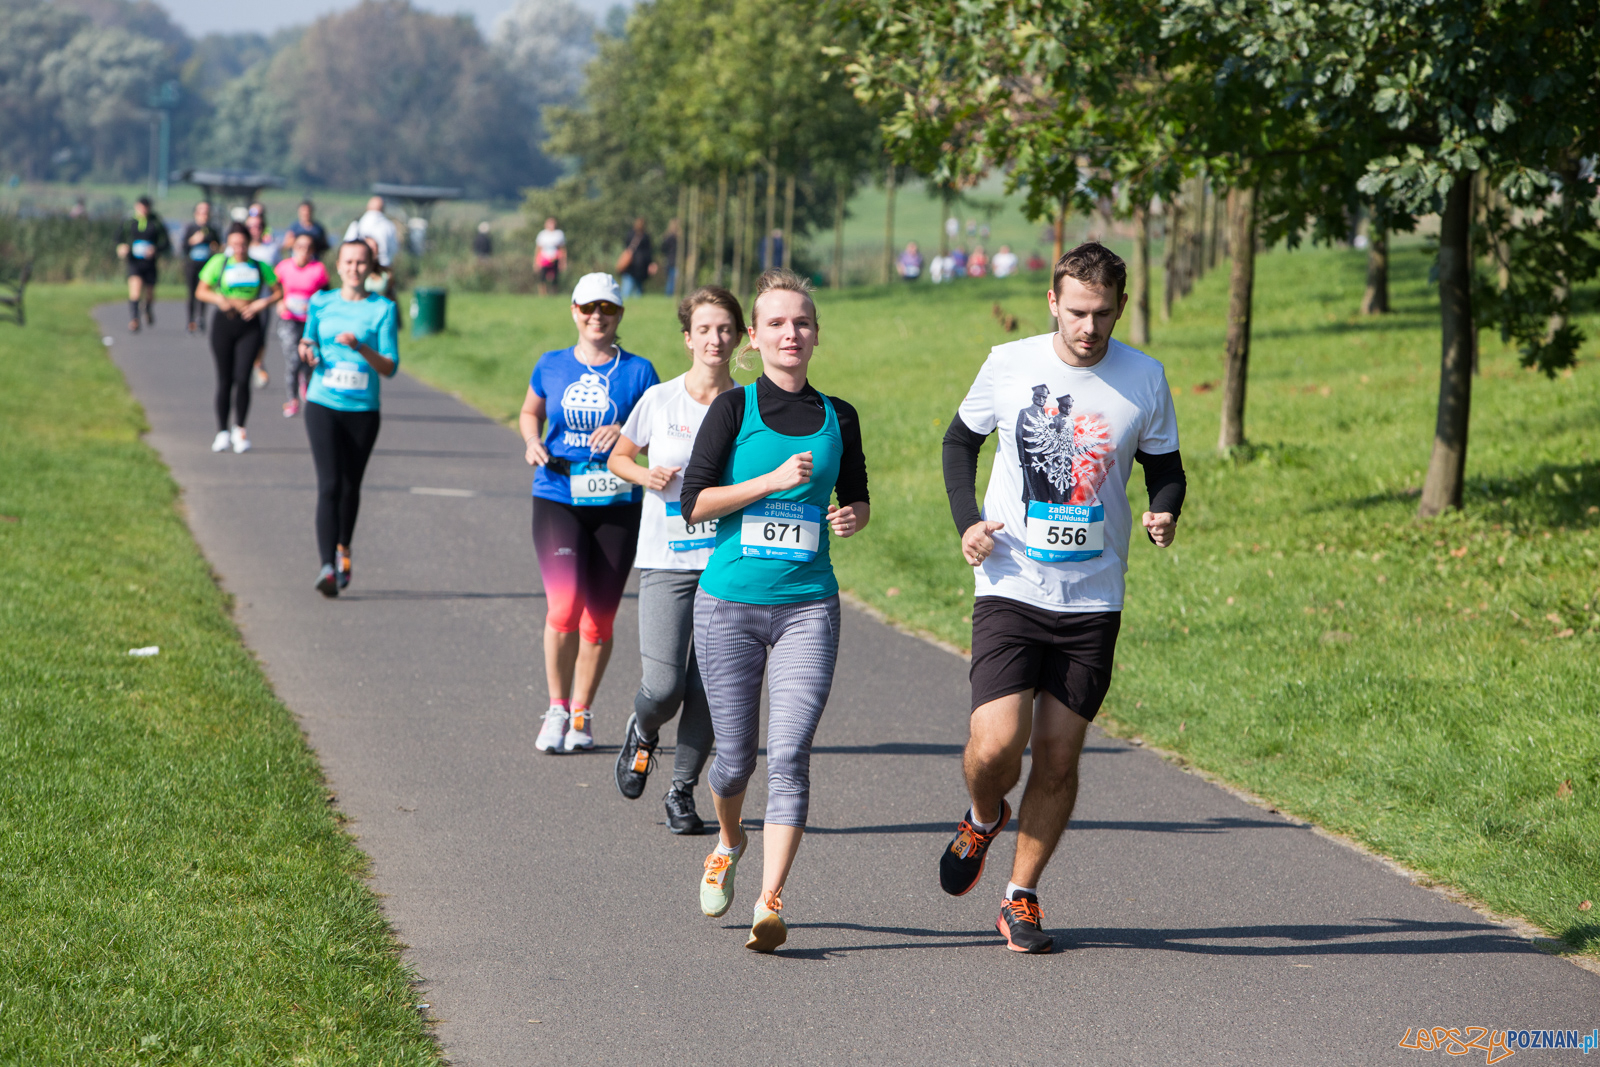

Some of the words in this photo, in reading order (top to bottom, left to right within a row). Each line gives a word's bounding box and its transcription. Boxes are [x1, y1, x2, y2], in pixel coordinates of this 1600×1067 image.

[563, 430, 590, 448] JUST
[588, 477, 618, 492] 035
[764, 502, 804, 514] zaBIEGaj
[770, 510, 804, 519] FUNdusze
[1048, 506, 1090, 517] zaBIEGaj
[1054, 514, 1089, 522] FUNdusze
[686, 520, 717, 535] 615
[763, 522, 801, 543] 671
[1046, 526, 1087, 546] 556
